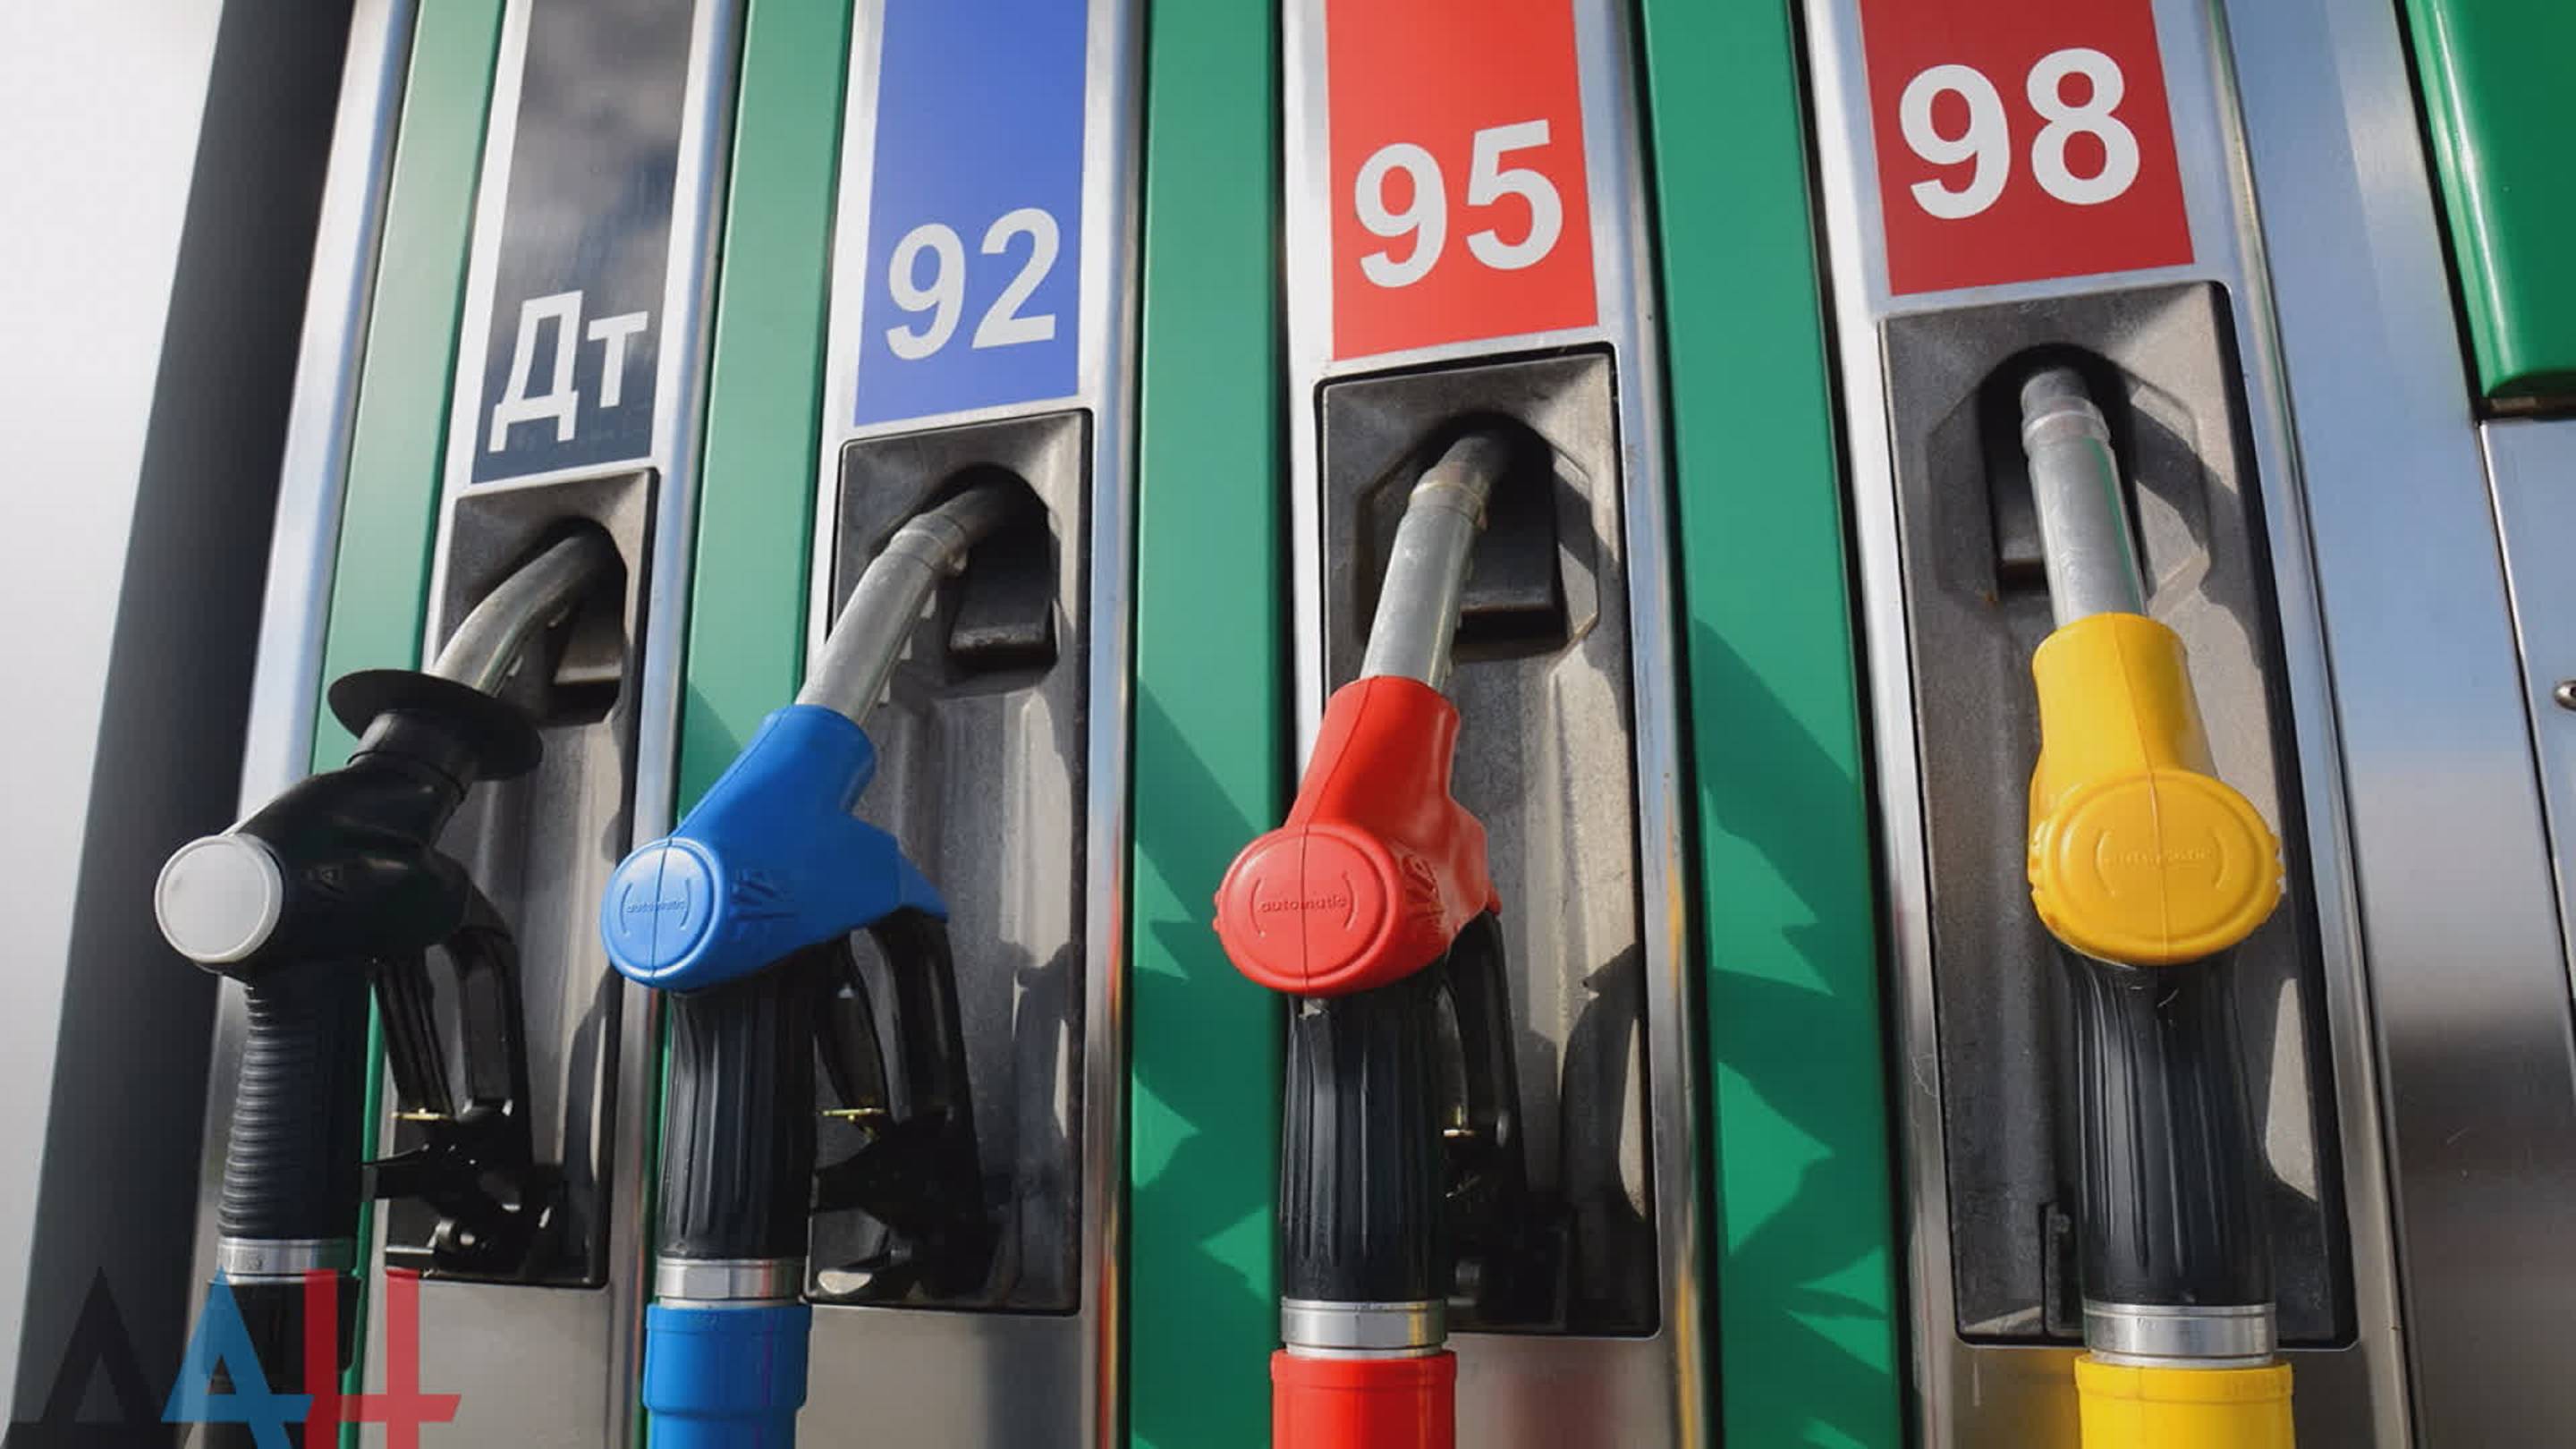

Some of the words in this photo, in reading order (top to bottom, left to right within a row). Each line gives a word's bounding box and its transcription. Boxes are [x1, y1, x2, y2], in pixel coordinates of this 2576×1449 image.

[1355, 120, 1563, 288] 95
[1900, 48, 2140, 219] 98
[886, 208, 1059, 360] 92
[488, 290, 649, 453] Дт
[1260, 894, 1348, 913] automatic
